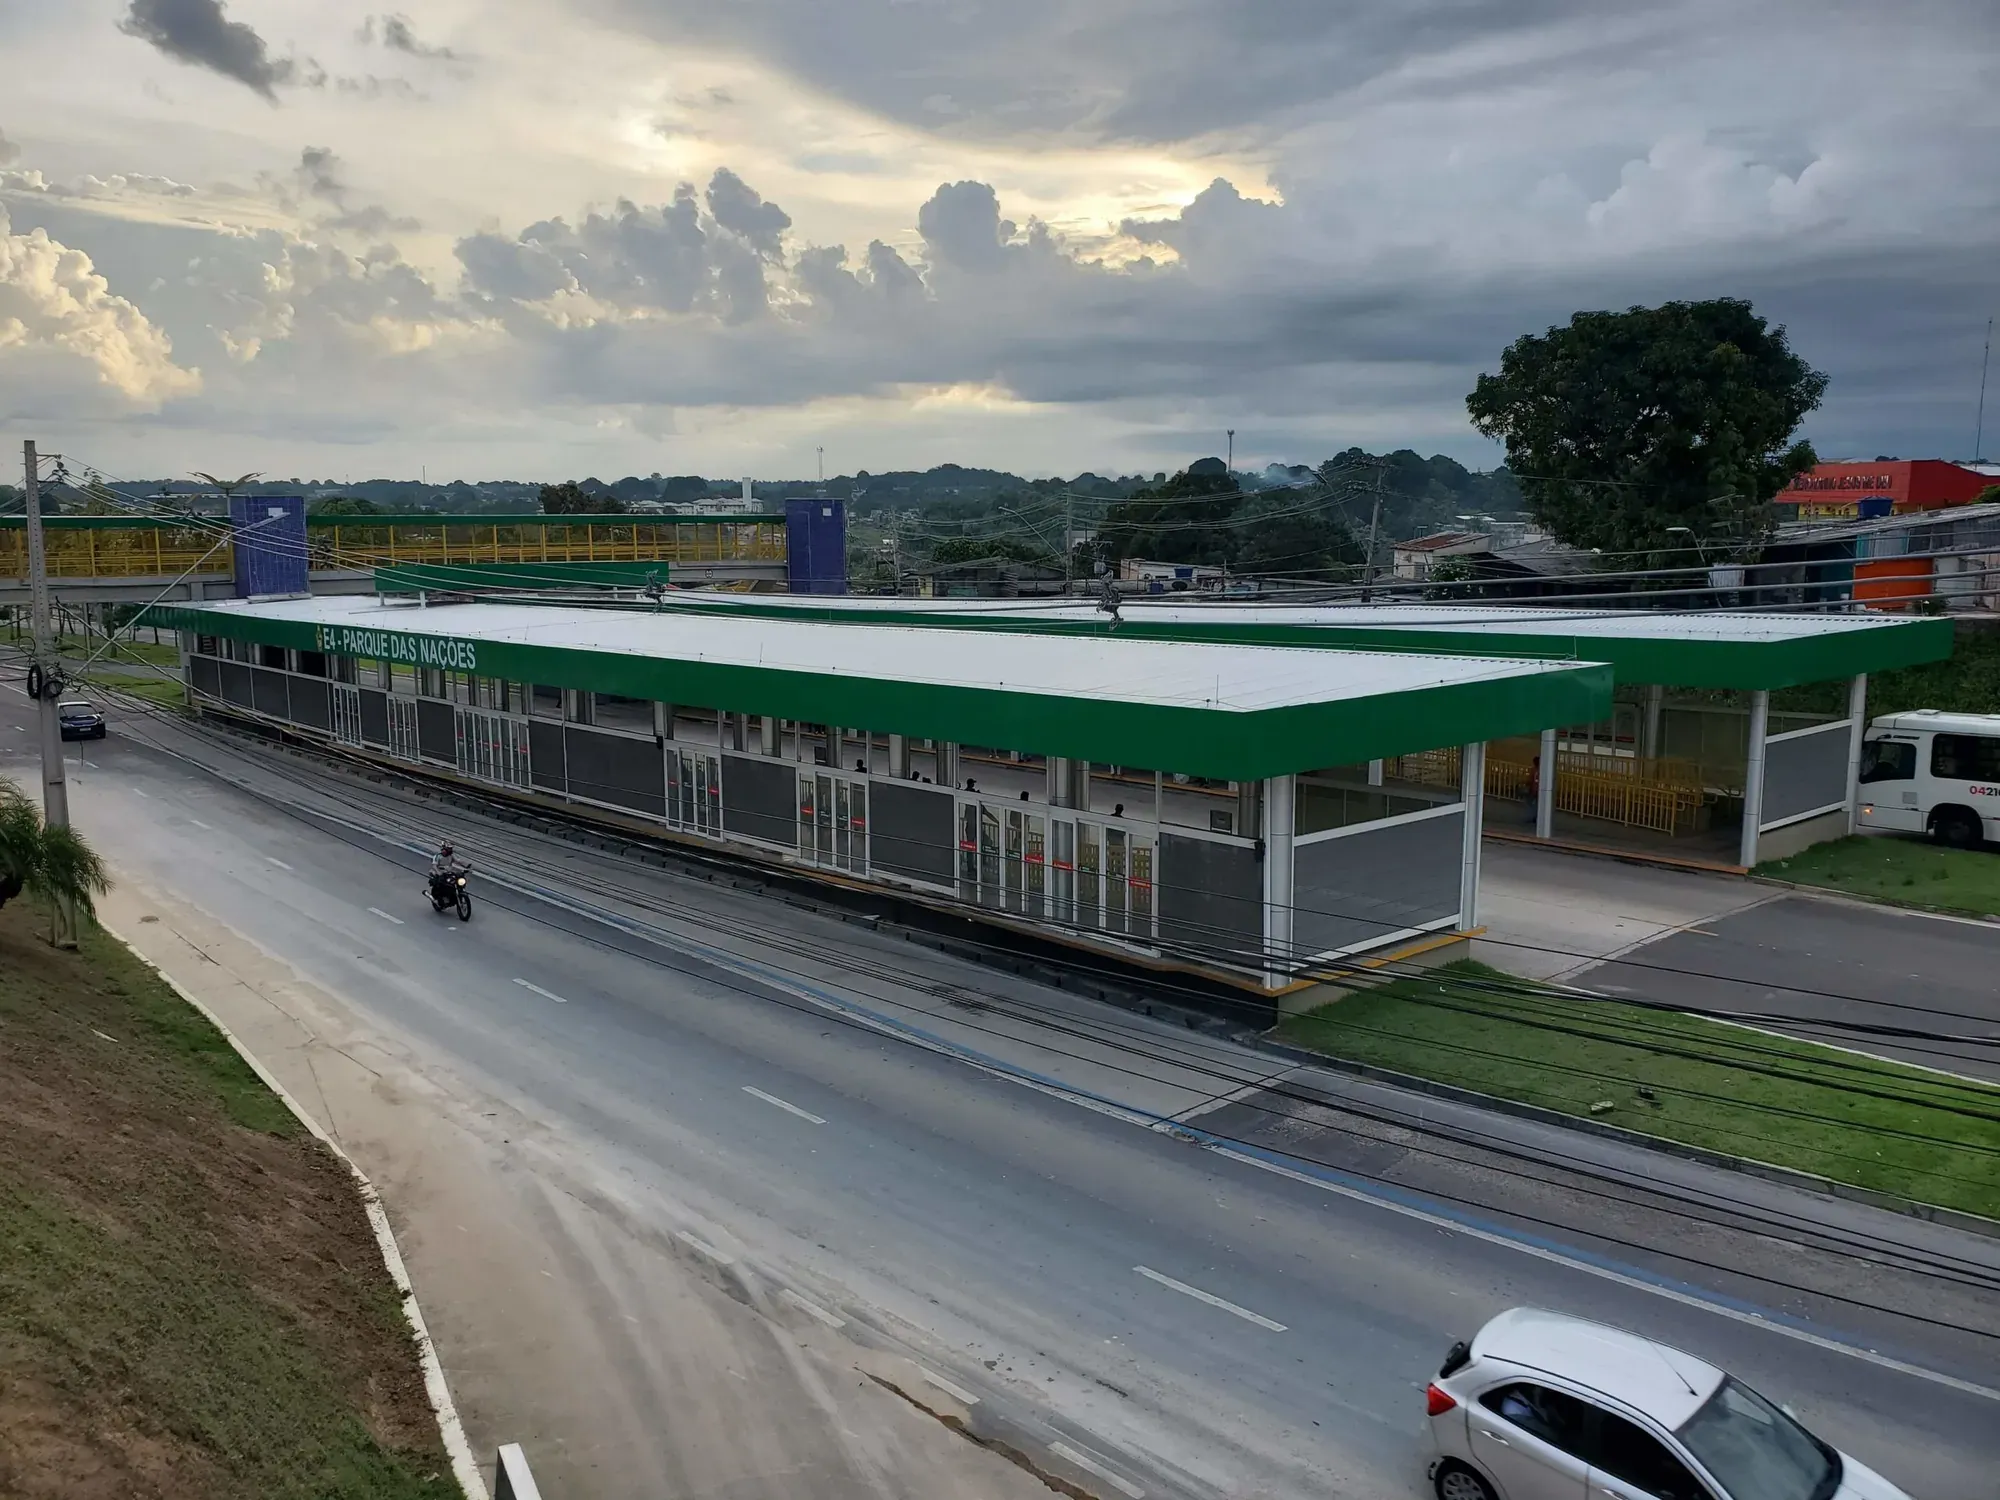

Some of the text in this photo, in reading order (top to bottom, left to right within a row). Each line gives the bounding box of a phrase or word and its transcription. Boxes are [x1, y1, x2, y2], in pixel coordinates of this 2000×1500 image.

[323, 627, 336, 650] E4
[343, 629, 389, 658] PARQUE
[391, 635, 417, 662] DAS
[420, 637, 476, 670] NAÇÕES
[1969, 785, 2000, 797] 0421
